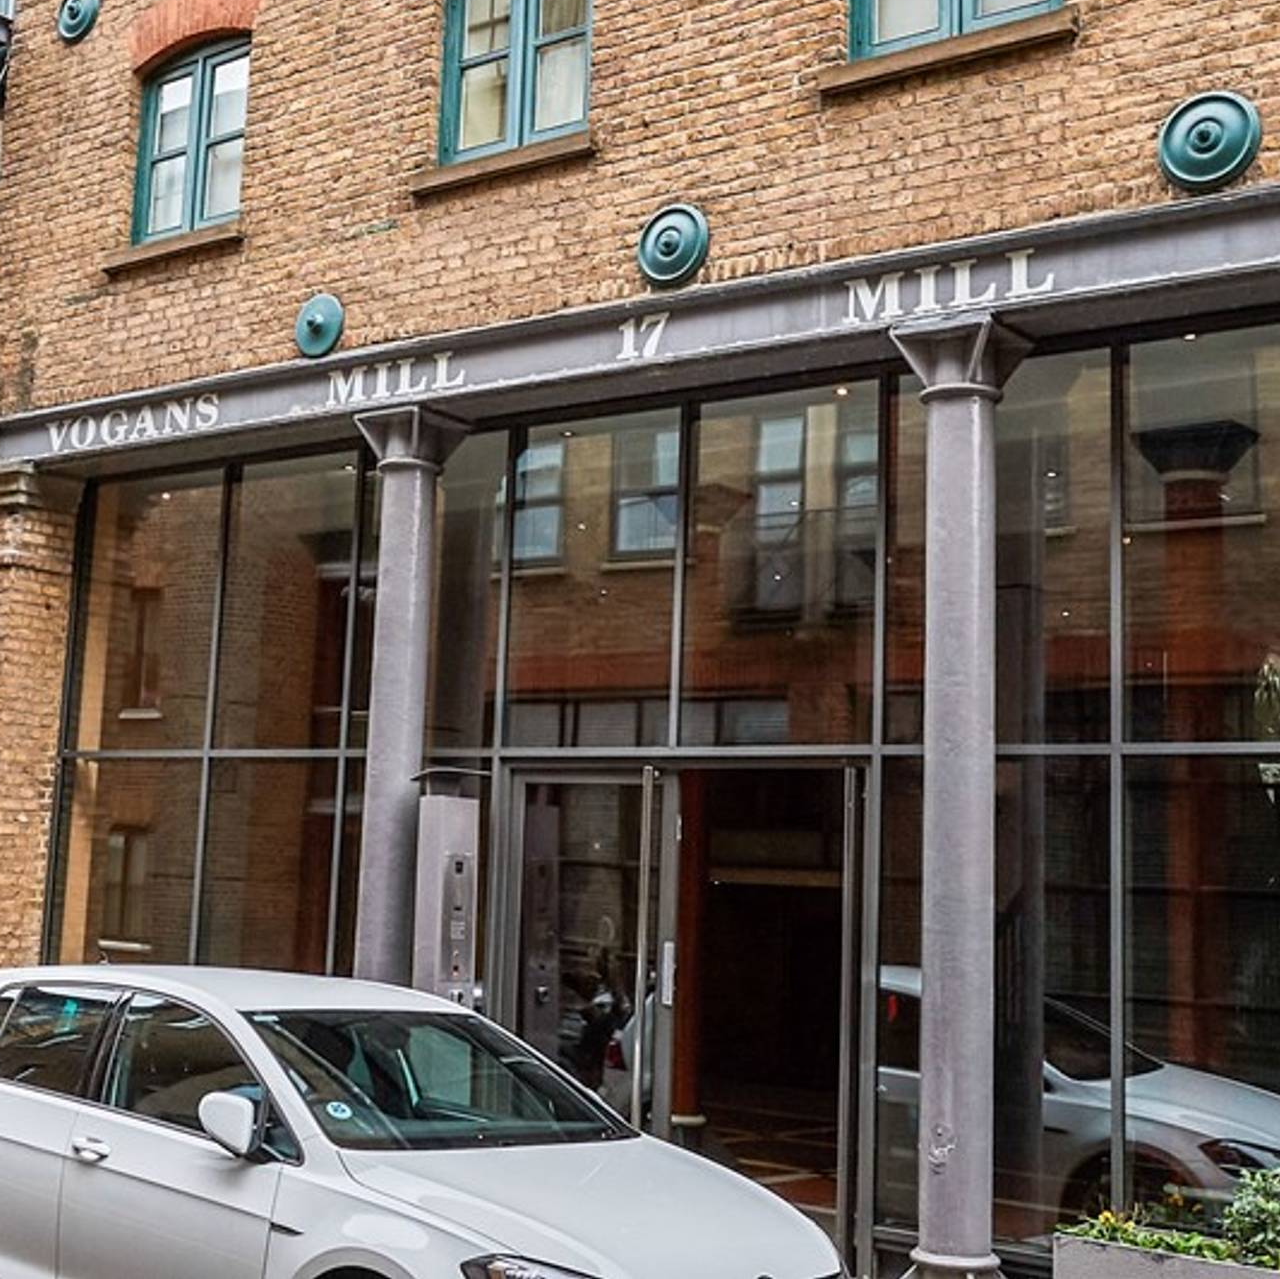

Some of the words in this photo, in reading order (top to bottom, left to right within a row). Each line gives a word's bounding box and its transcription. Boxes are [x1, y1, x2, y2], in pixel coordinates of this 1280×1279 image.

[46, 393, 220, 453] VOGANS
[325, 351, 466, 407] MILL
[616, 311, 671, 360] 17
[842, 248, 1055, 323] MILL
